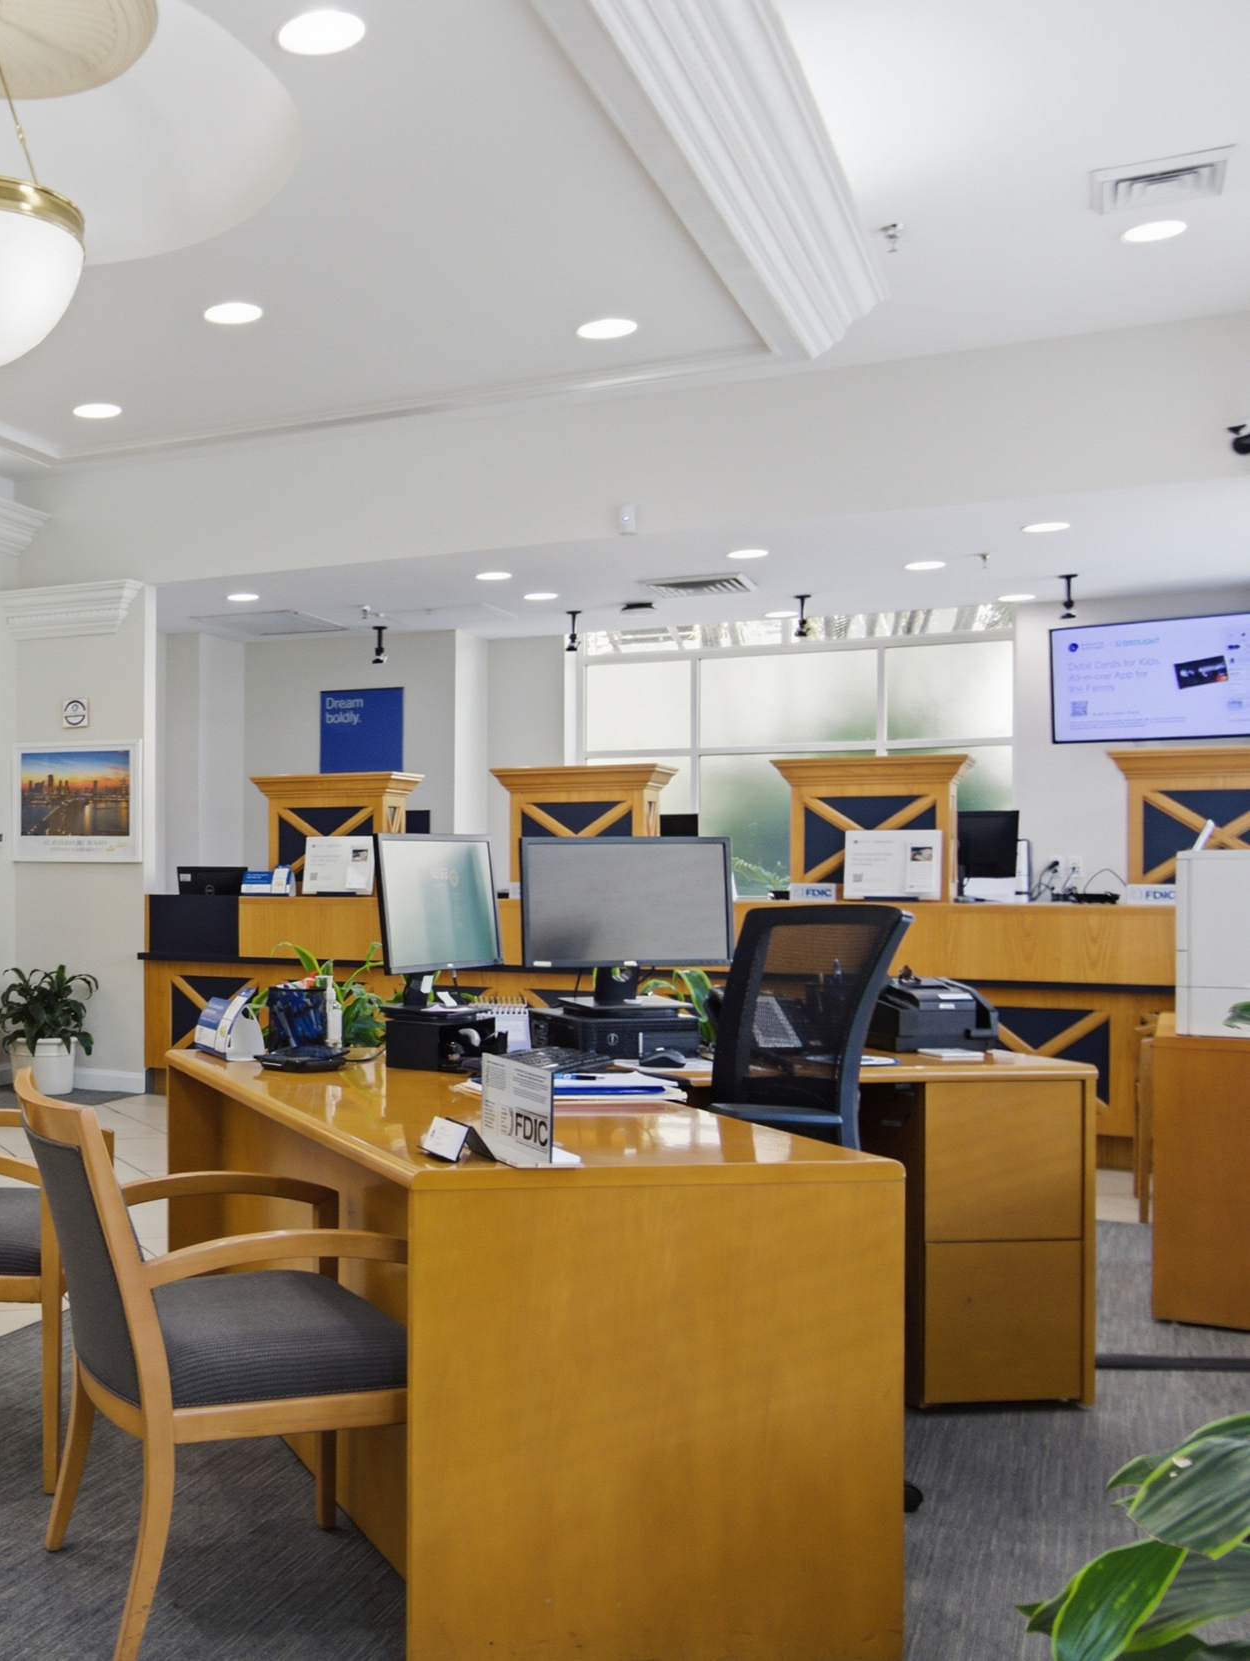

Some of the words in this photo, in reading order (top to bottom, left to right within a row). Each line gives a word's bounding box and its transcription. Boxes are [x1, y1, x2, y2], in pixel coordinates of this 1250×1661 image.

[326, 697, 364, 709] Dream
[325, 710, 362, 725] boldly.
[806, 888, 832, 897] FDIC
[1145, 890, 1176, 899] FDIC
[515, 1112, 548, 1147] FDIC
